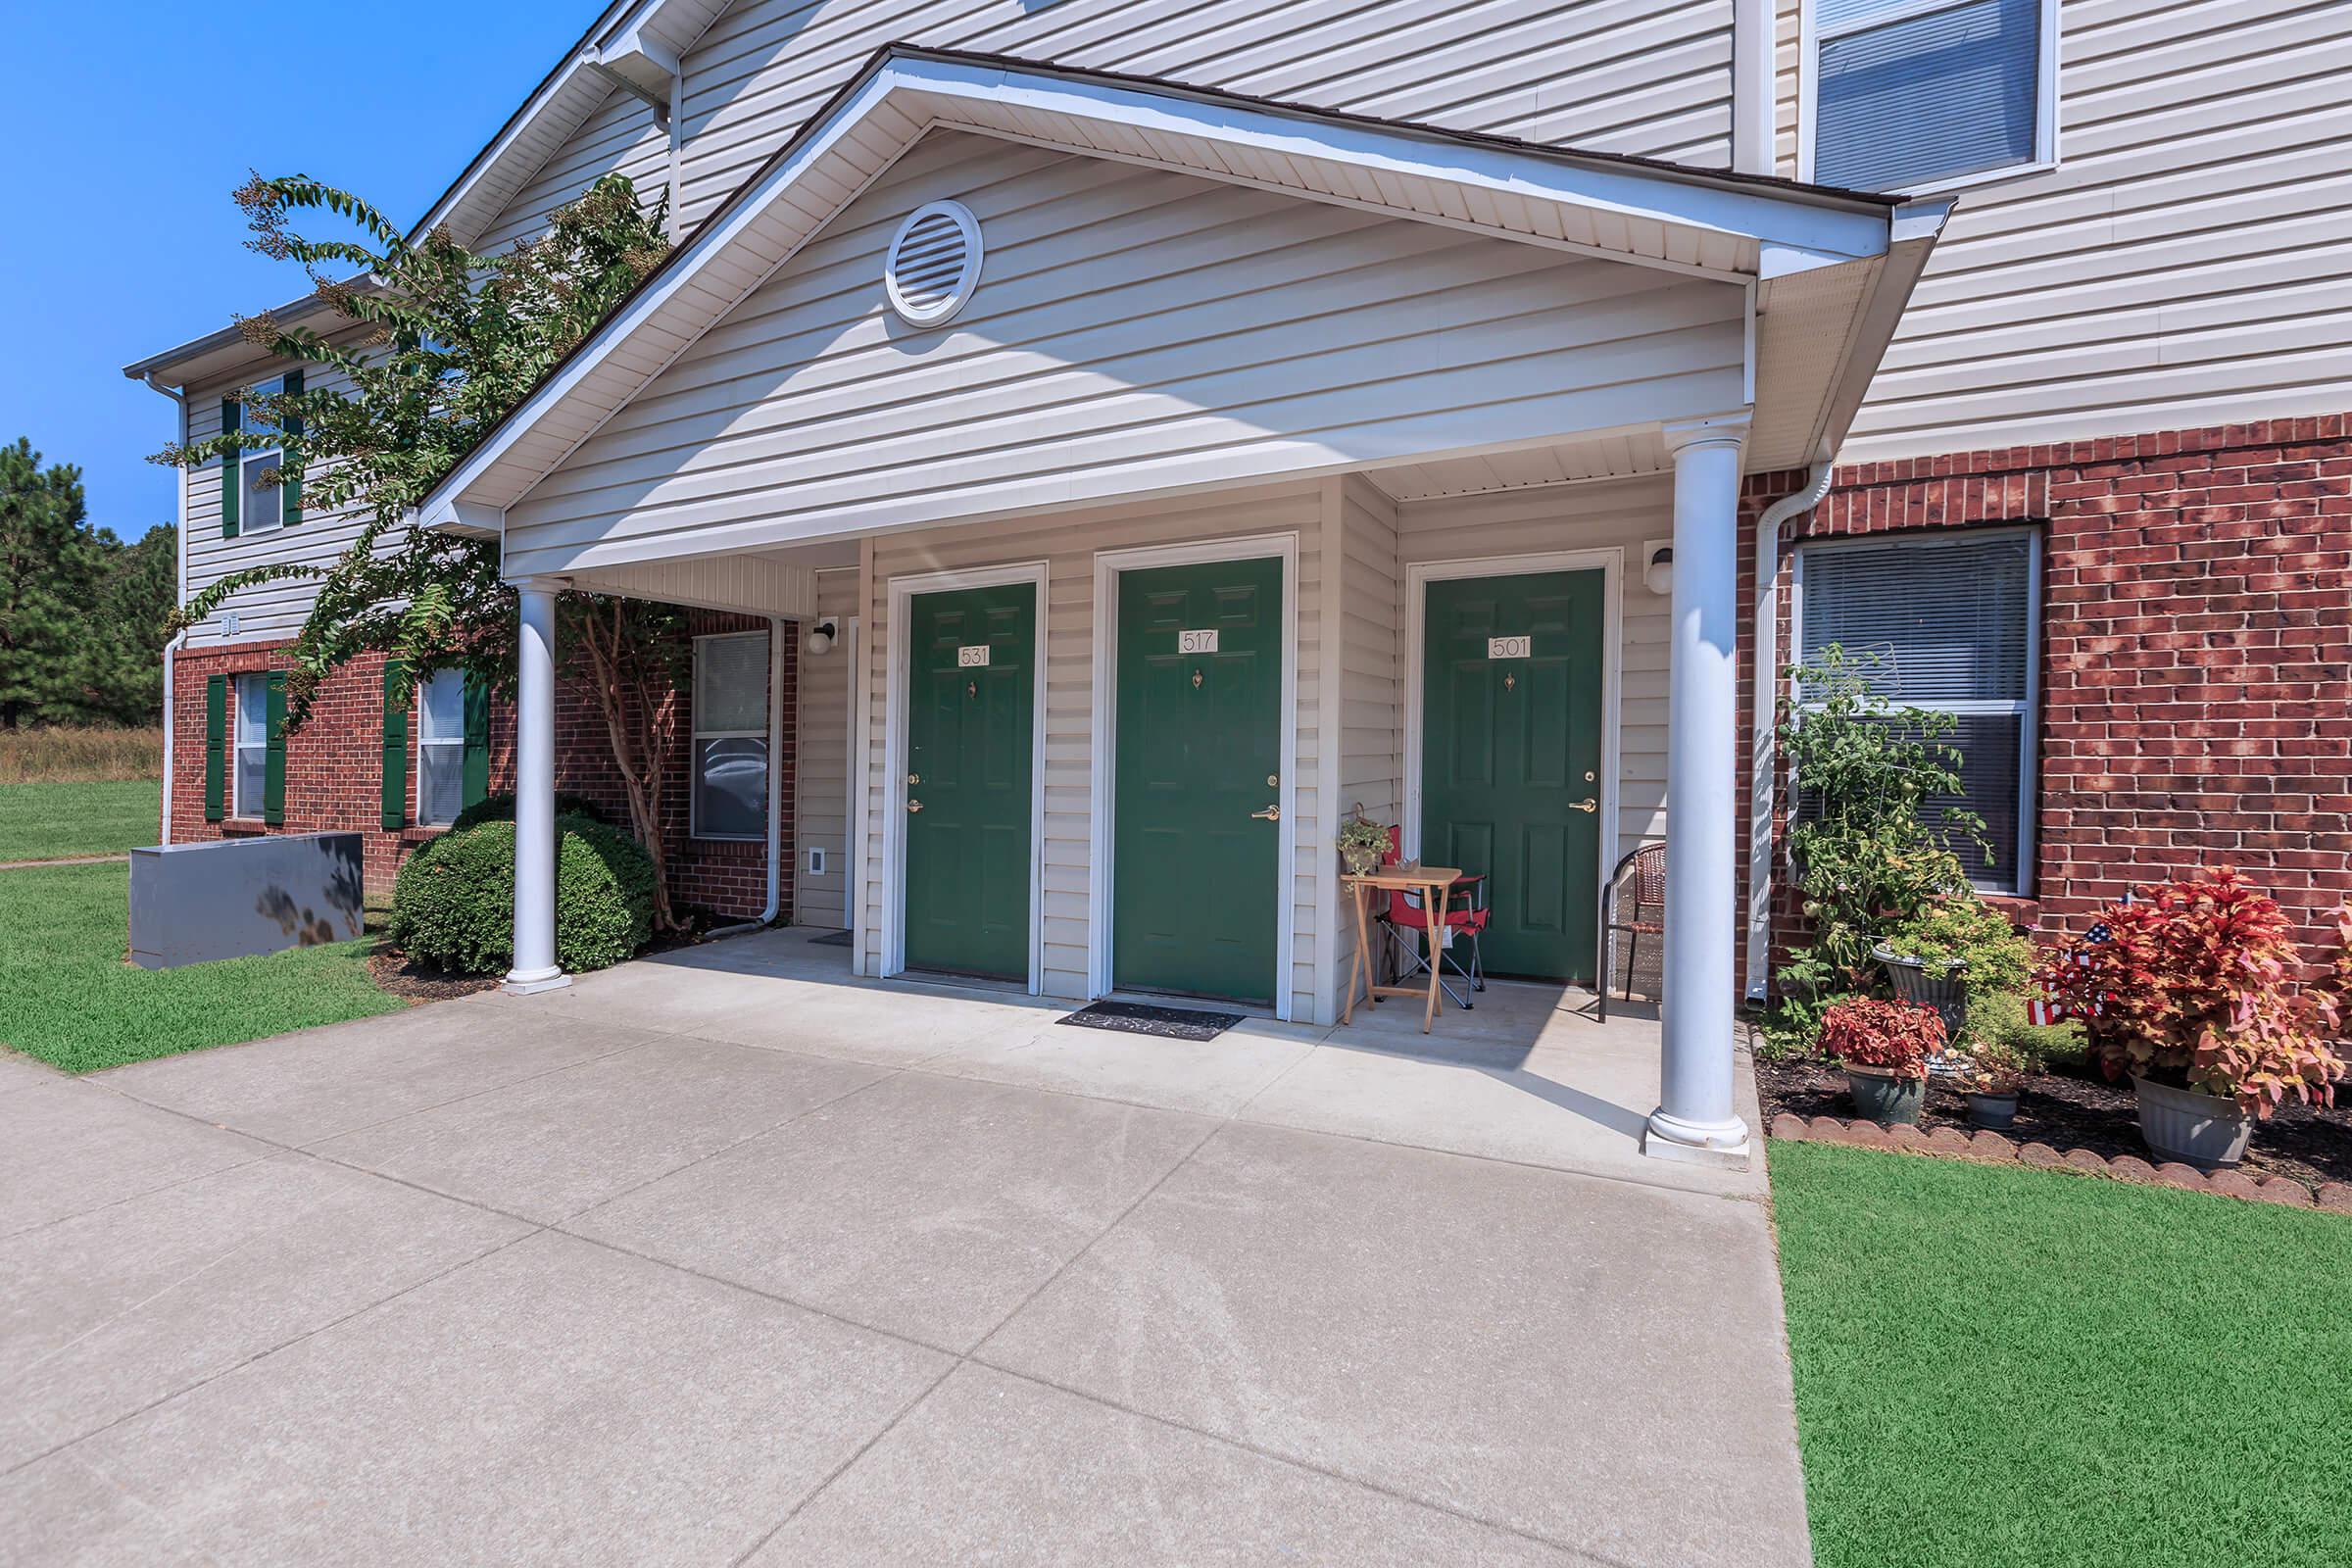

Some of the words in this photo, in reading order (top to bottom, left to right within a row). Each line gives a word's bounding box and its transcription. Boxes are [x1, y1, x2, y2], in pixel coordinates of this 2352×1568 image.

[1184, 632, 1213, 651] 517
[1493, 638, 1526, 657] 501
[962, 648, 987, 664] 531
